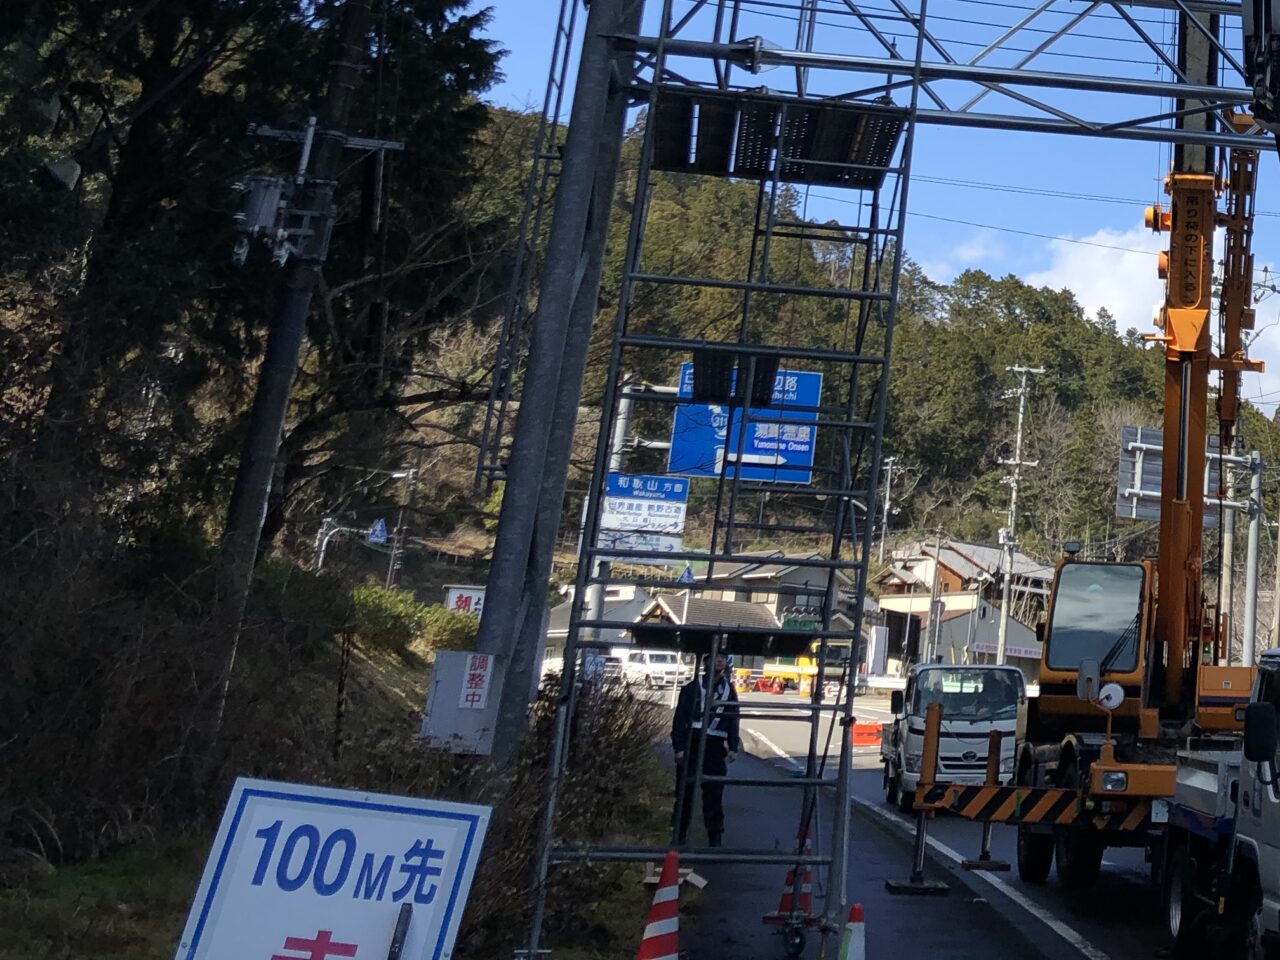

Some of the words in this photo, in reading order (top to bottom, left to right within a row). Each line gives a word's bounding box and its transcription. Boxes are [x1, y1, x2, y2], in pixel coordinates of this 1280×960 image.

[788, 442, 810, 452] Onsen
[465, 655, 489, 708] 調整中
